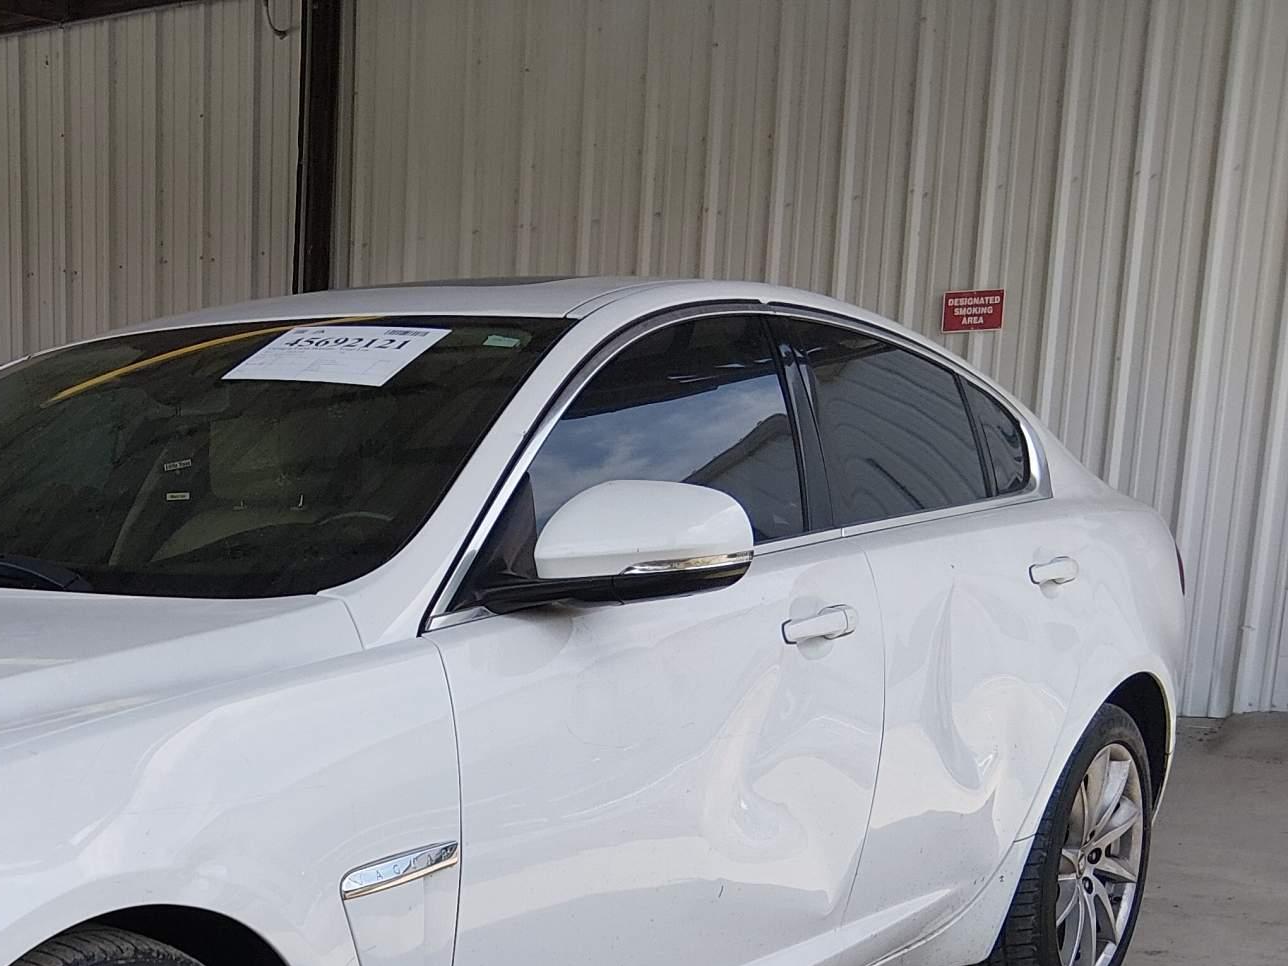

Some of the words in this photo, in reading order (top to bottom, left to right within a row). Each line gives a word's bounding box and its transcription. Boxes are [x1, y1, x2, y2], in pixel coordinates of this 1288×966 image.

[948, 296, 1000, 306] DESIGNATED
[954, 306, 993, 316] SMOKING
[961, 317, 984, 325] AREA
[285, 337, 411, 349] 45692121
